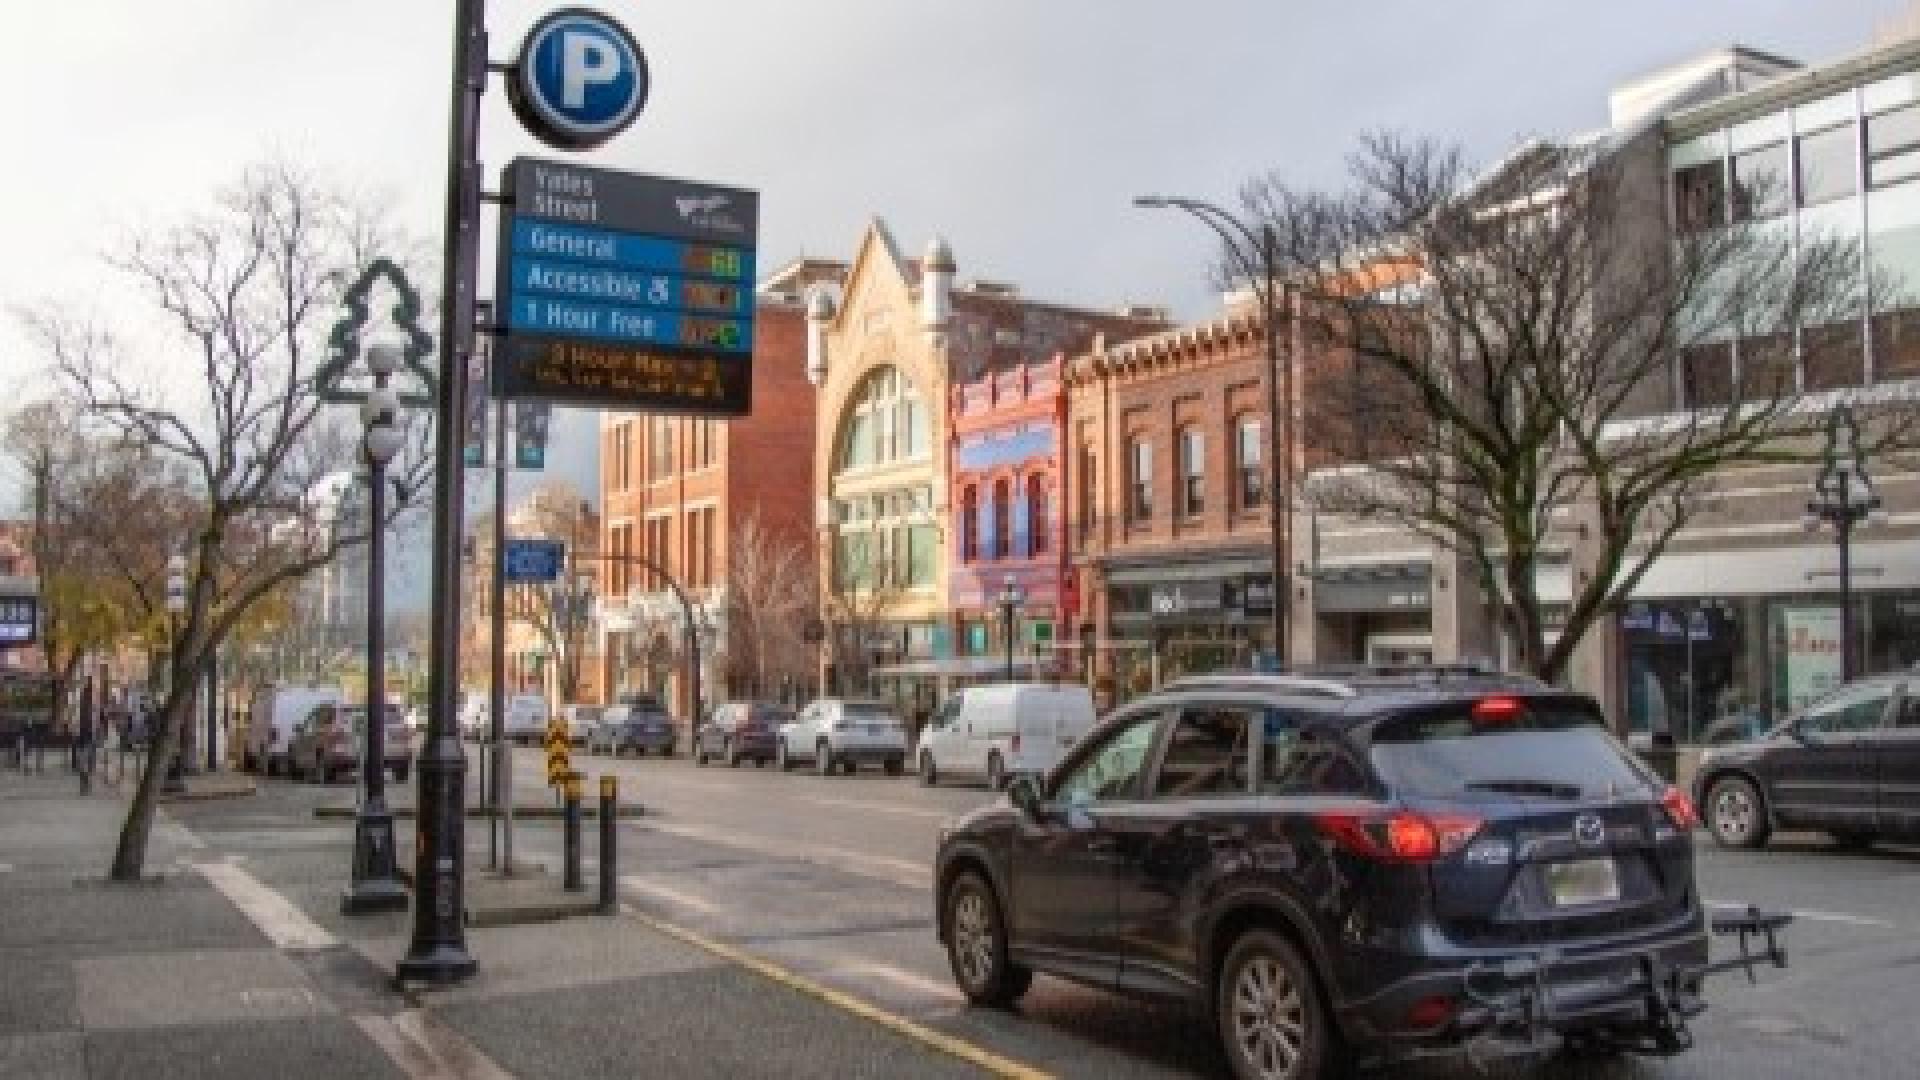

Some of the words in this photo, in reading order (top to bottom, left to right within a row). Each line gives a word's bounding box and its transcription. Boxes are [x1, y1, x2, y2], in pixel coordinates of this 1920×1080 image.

[563, 31, 621, 109] P
[535, 167, 593, 197] Yates
[535, 195, 597, 221] Street
[531, 227, 617, 261] General
[527, 263, 641, 299] Accessible
[526, 299, 538, 323] 1
[547, 301, 597, 330] Hour
[611, 310, 655, 338] Free
